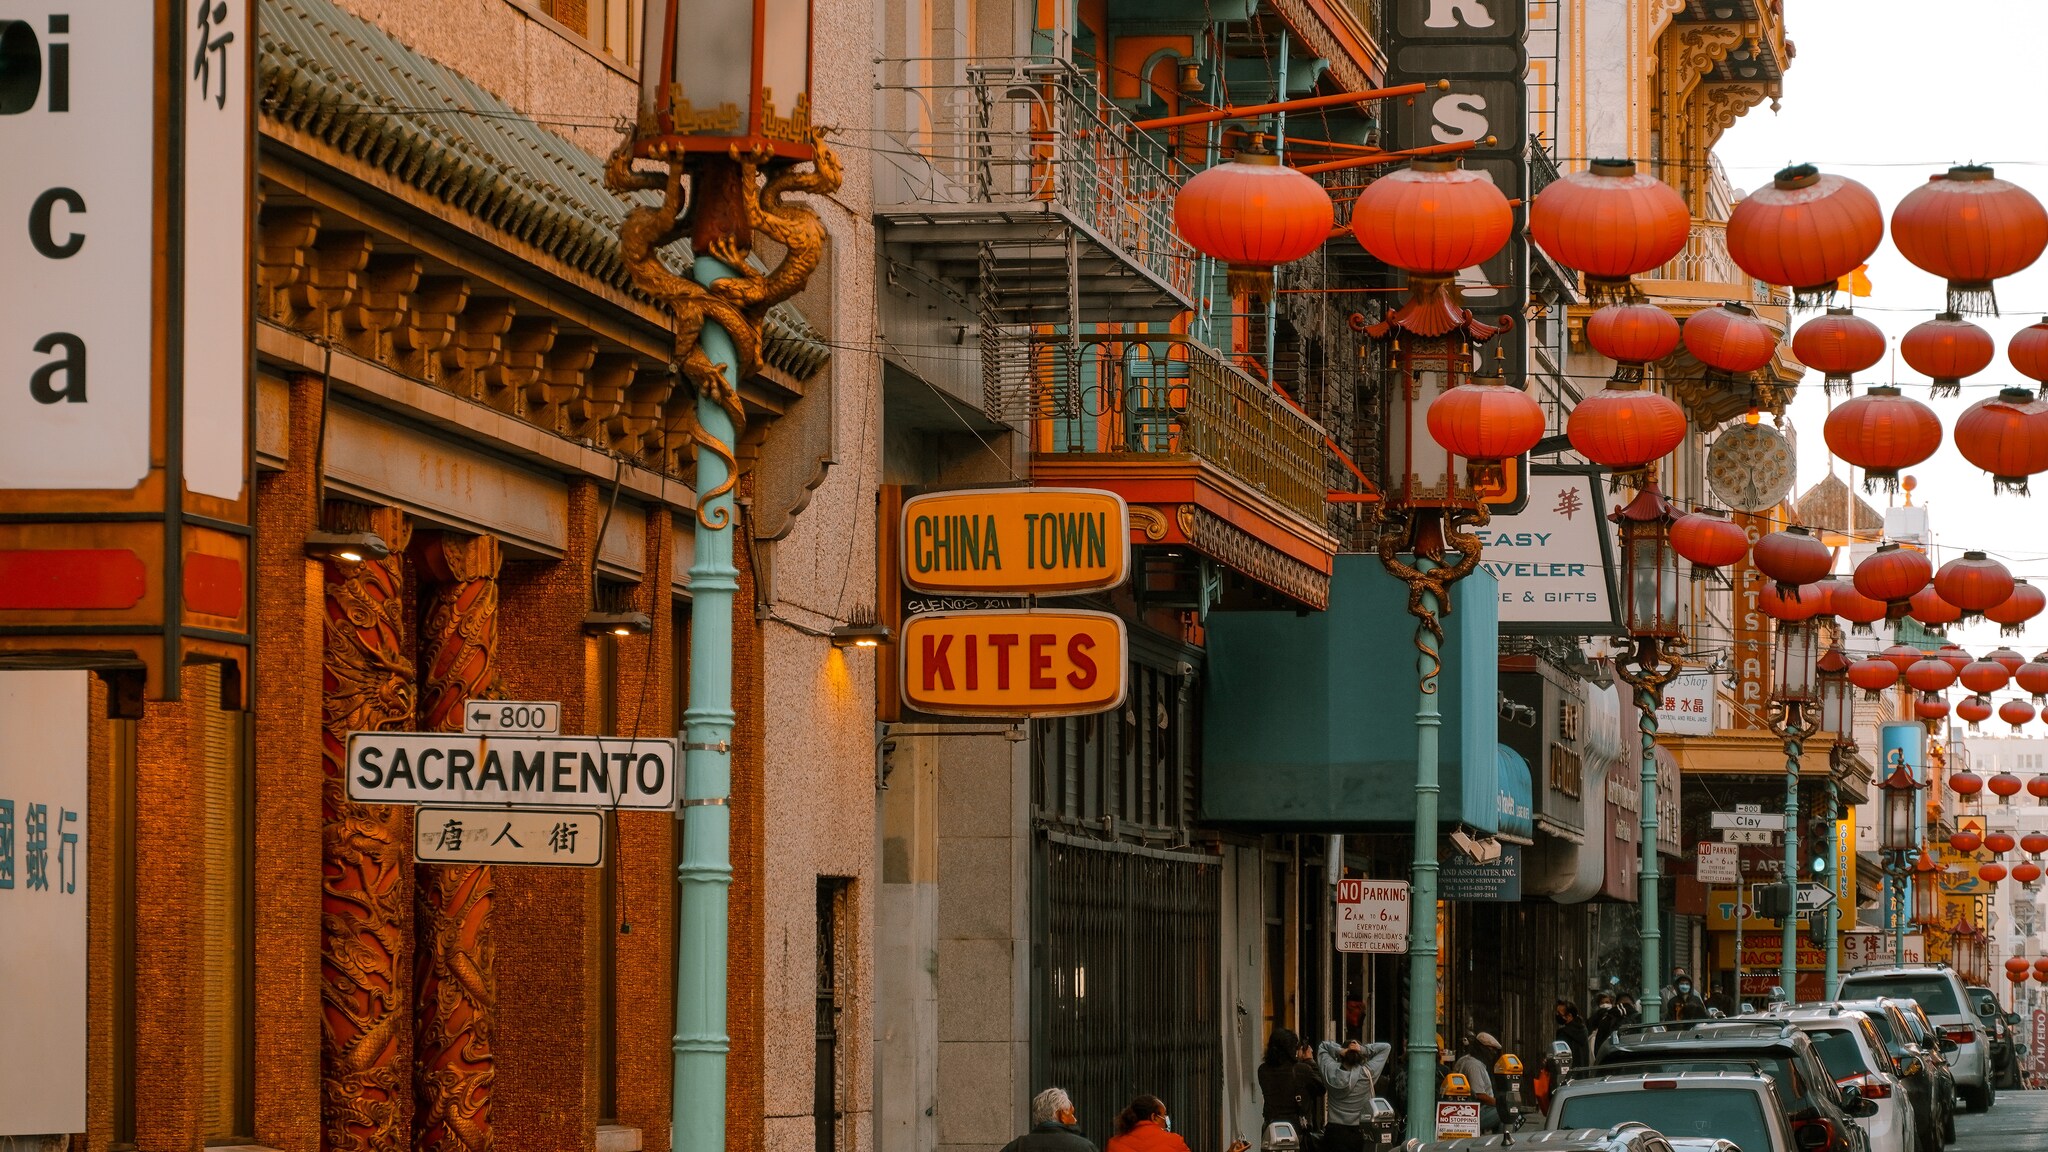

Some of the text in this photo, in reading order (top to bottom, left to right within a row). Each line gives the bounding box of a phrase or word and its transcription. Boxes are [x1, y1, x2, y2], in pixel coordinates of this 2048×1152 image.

[1552, 486, 1583, 521] 華
[914, 512, 1106, 573] CHINA TOWN
[1475, 531, 1552, 547] EASY
[1483, 563, 1586, 577] AVELER
[984, 599, 1010, 609] 2011
[1522, 591, 1535, 603] &
[1545, 592, 1597, 602] GIFTS
[922, 633, 1097, 691] KITES
[1683, 675, 1708, 690] Shop
[499, 706, 546, 728] 800
[356, 747, 665, 796] SACRAMENTO
[1744, 805, 1758, 813] 800
[1736, 816, 1761, 828] Clay
[435, 819, 578, 855] 唐人街
[1700, 843, 1737, 855] NO PARKING
[1340, 882, 1405, 902] NO PARKING
[1797, 892, 1811, 902] AY
[1356, 923, 1388, 931] EVERYDAY
[1341, 931, 1403, 941] INCLUDING HOLIDAYS
[1743, 935, 1816, 949] SHITS
[1344, 941, 1400, 950] STREET CLEANING
[2035, 1013, 2046, 1070] SHISEIDO
